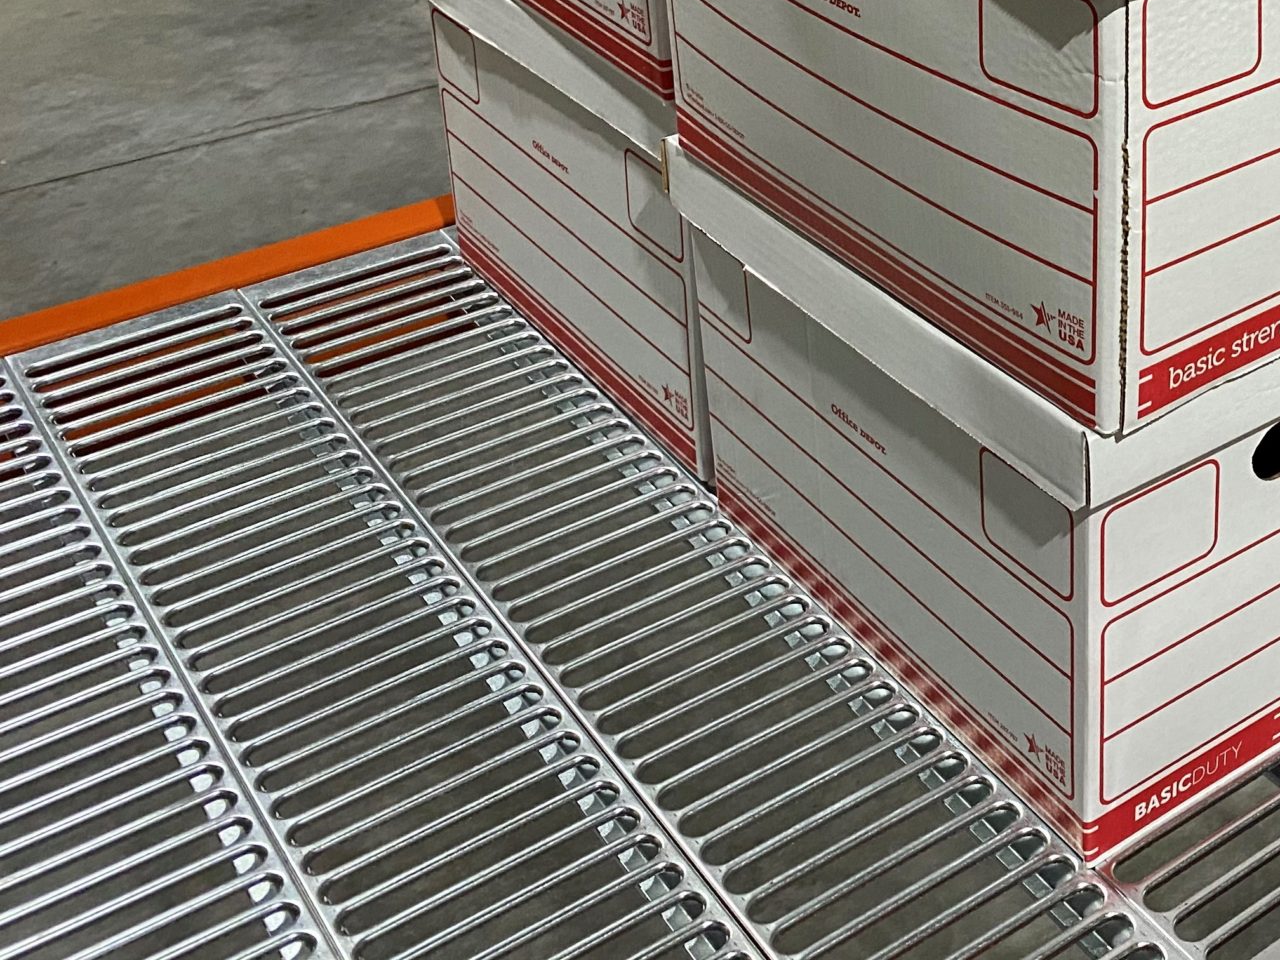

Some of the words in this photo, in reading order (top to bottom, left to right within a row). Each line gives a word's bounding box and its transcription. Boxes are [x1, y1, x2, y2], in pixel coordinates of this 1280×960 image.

[1057, 308, 1085, 330] MADE
[1058, 319, 1067, 331] IN
[1068, 324, 1085, 340] THE
[1058, 329, 1085, 352] USA
[1168, 346, 1226, 390] basic
[830, 402, 859, 433] Office
[1133, 739, 1243, 822] BASICDUTY
